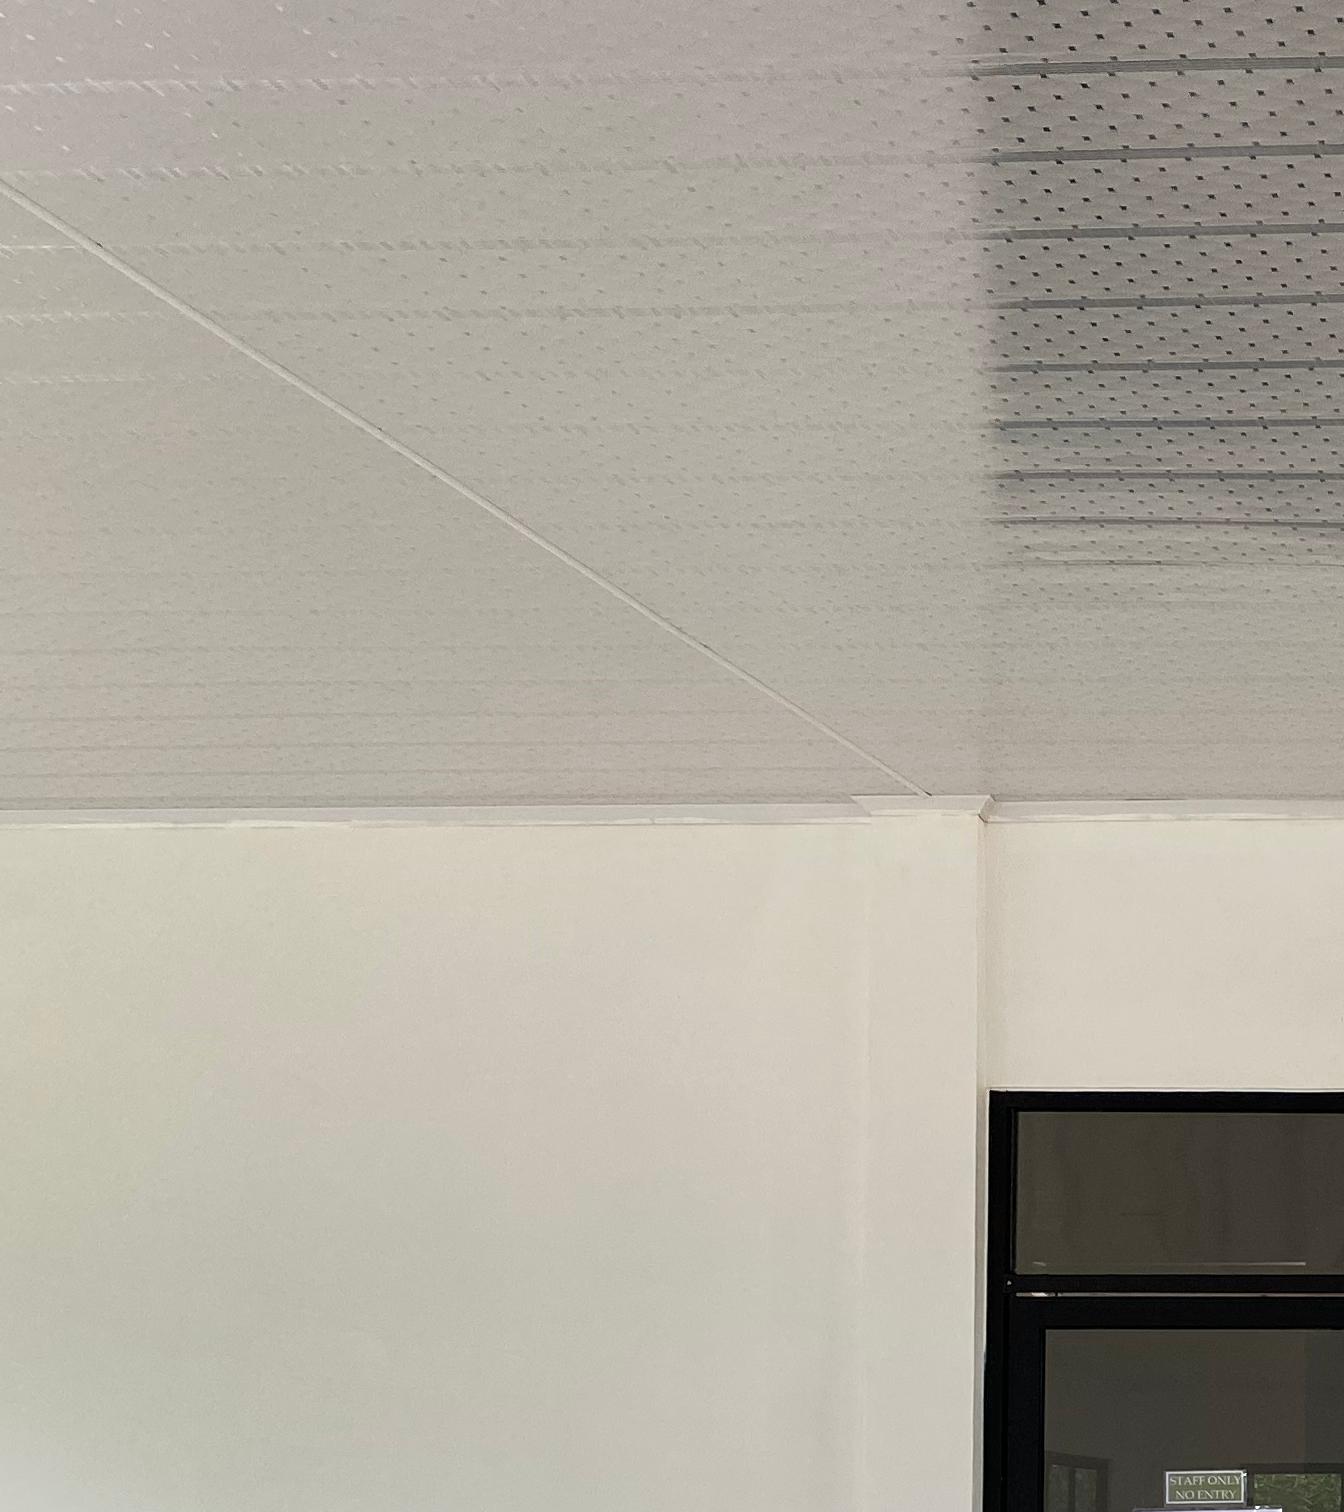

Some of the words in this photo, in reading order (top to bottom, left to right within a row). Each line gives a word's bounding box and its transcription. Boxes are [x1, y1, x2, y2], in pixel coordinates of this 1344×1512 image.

[1169, 1475, 1205, 1486] STAFF
[1207, 1475, 1241, 1485] ONLY
[1175, 1490, 1195, 1499] NO
[1198, 1489, 1237, 1499] ENTRY
